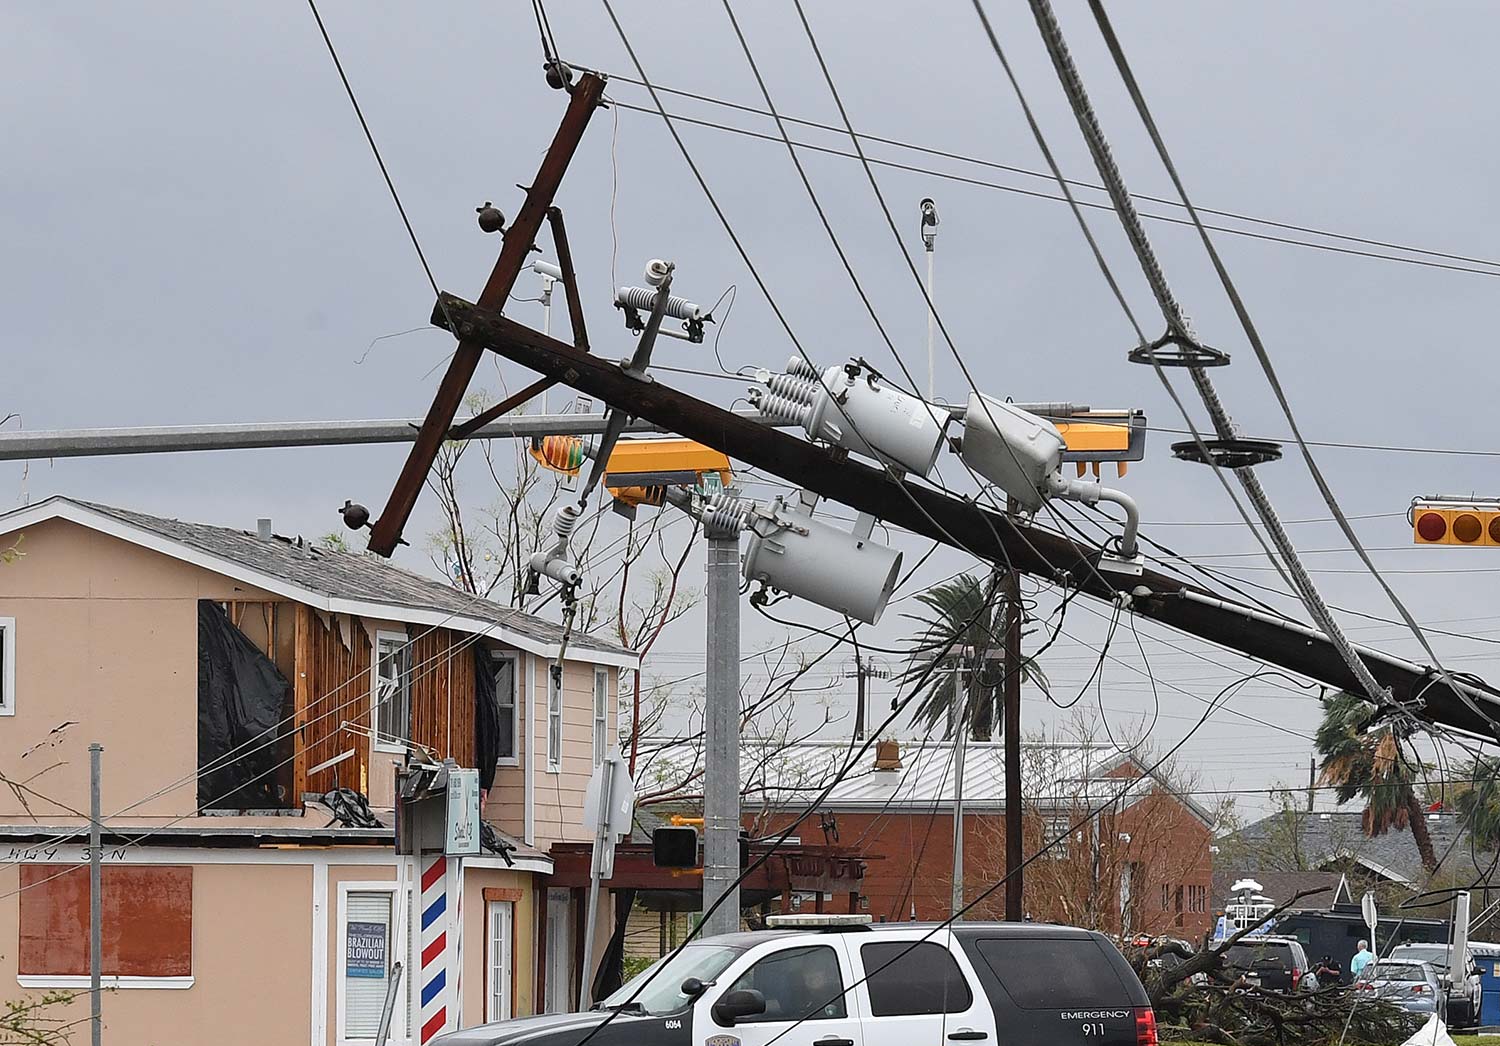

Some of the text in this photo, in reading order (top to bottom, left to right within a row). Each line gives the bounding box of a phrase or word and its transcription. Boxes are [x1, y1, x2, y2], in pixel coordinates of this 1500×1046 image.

[348, 937, 384, 948] BRAZILIAN
[347, 948, 384, 960] BLOWOUT
[1061, 1010, 1130, 1020] EMERGENCY
[1082, 1023, 1105, 1036] 911
